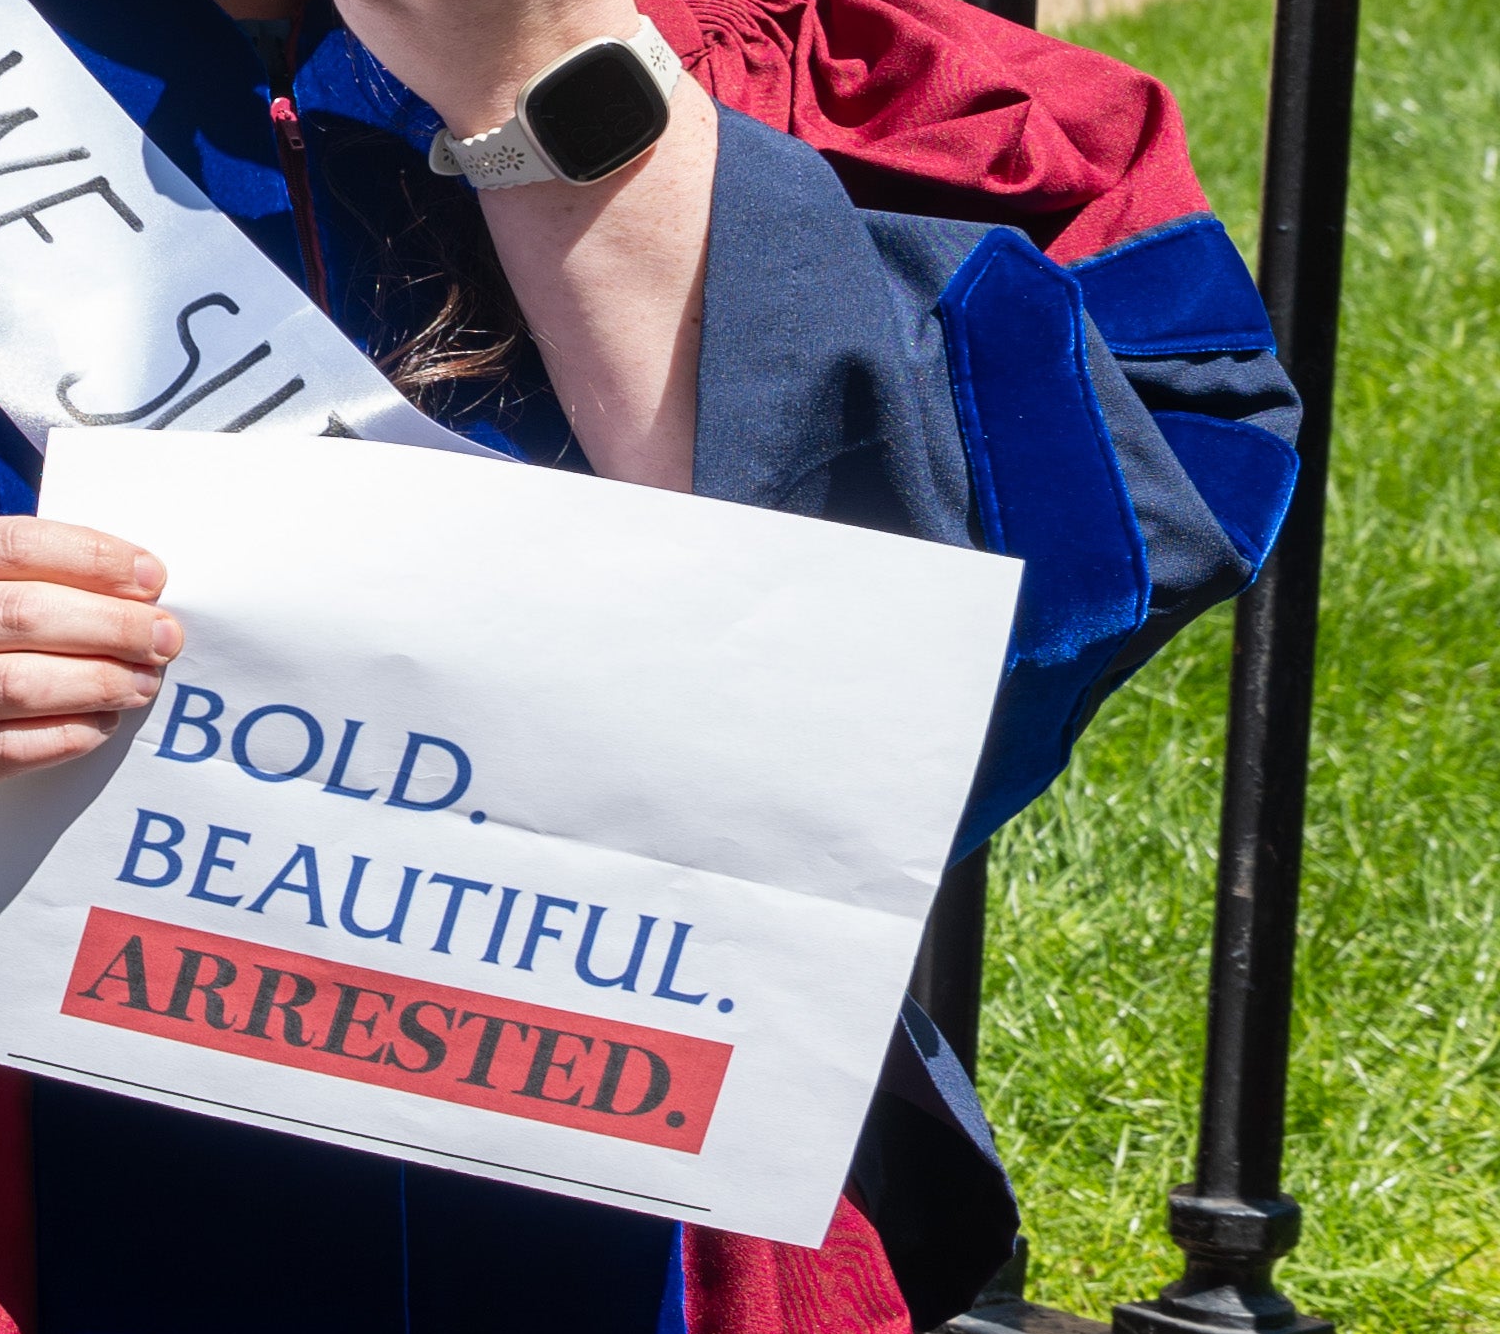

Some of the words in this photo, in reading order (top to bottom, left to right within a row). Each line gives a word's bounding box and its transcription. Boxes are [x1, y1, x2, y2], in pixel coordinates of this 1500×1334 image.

[155, 683, 489, 825] BOLD.
[117, 807, 738, 1014] BEAUTIFUL.
[79, 932, 687, 1129] ARRESTED.
